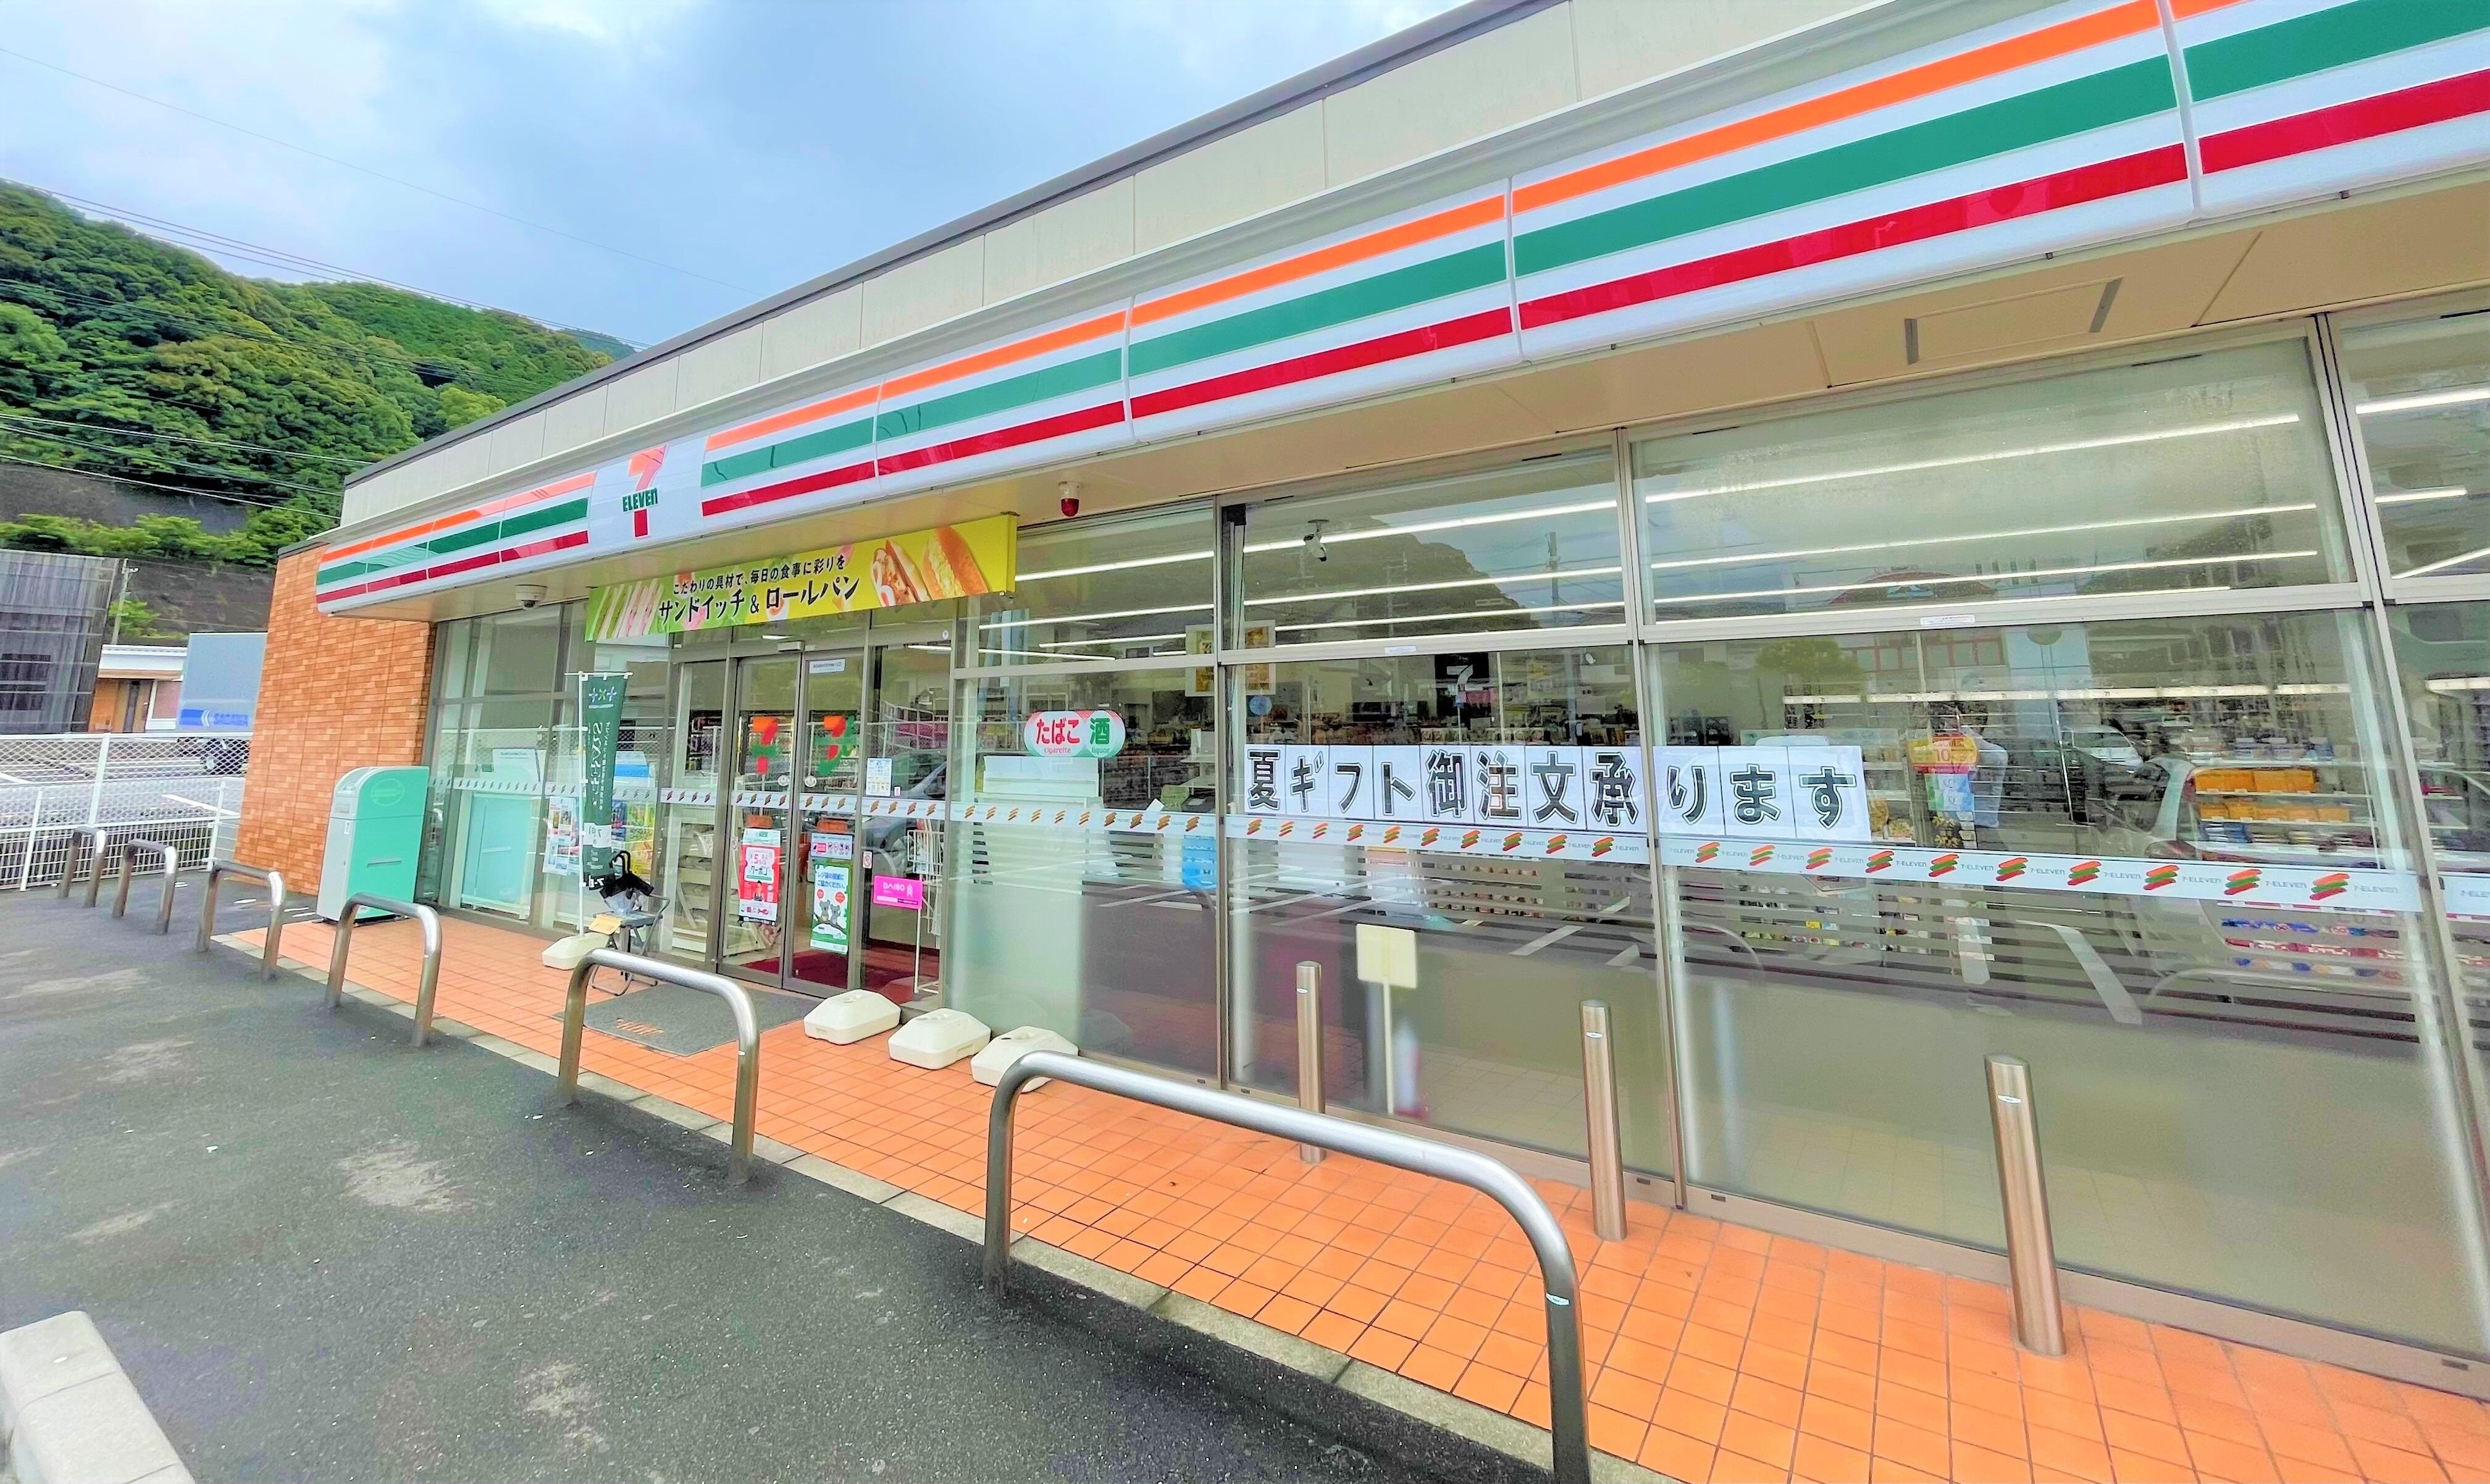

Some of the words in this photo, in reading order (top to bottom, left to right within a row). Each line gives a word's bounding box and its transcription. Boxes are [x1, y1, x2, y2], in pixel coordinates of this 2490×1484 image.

[673, 555, 845, 595] こだわりの具材で、毎日の食事に彩りを
[1036, 717, 1080, 745] たばこ
[1089, 717, 1110, 745] 酒
[1044, 746, 1071, 754] cigarette
[1091, 746, 1110, 755] liquor
[1247, 748, 1857, 830] 夏ギフト御注文承ります
